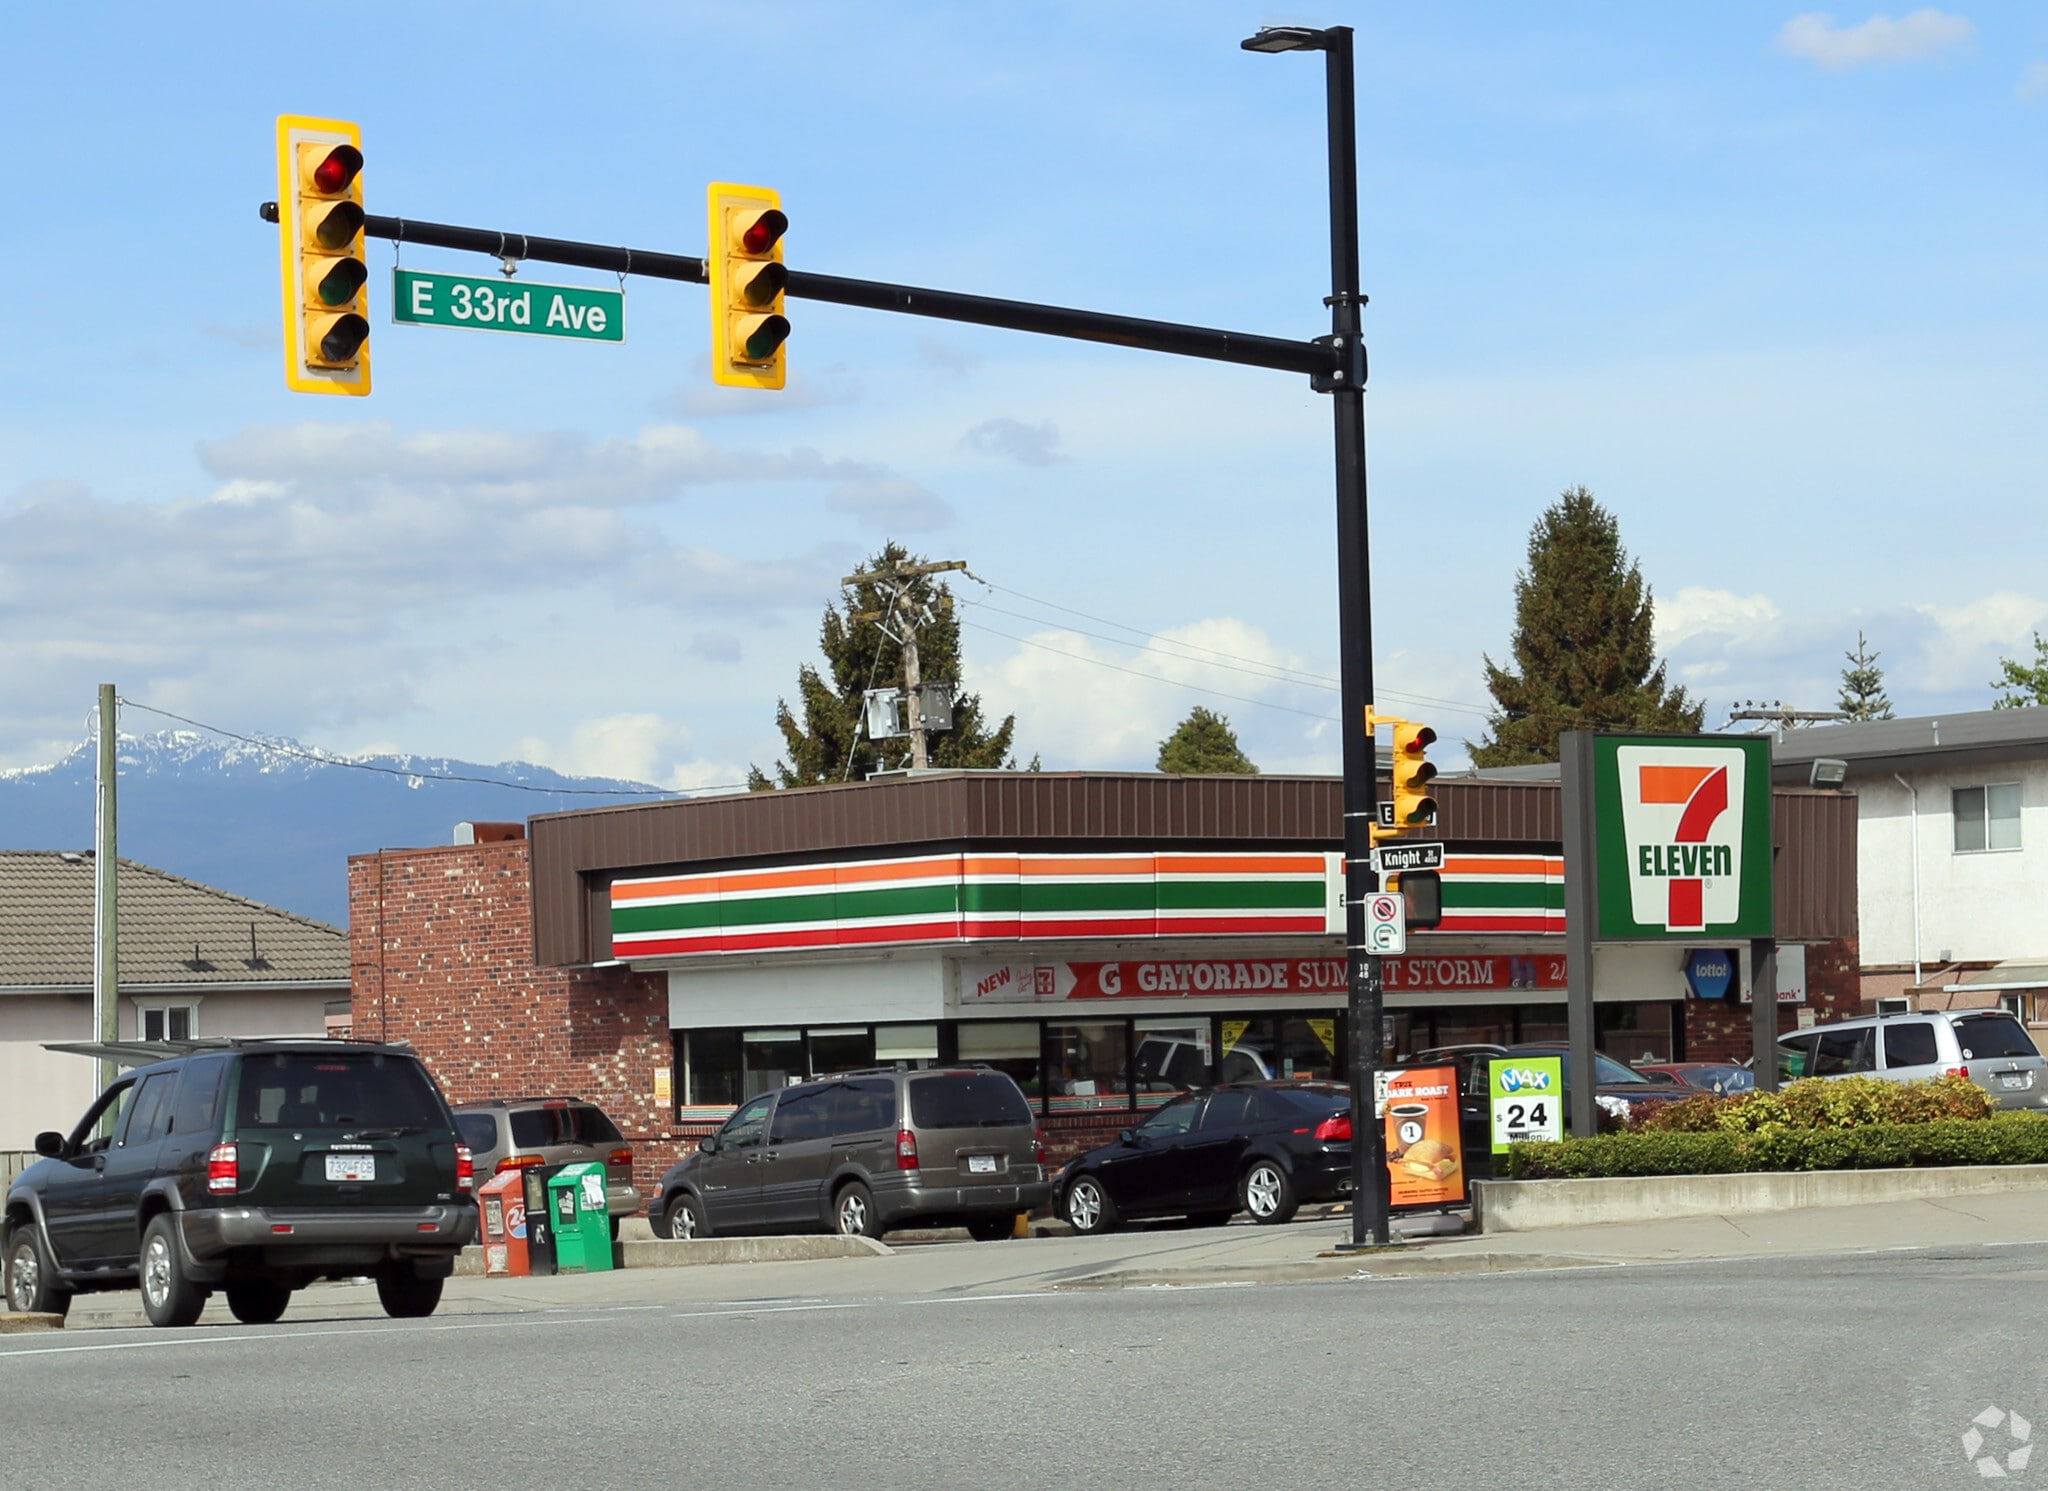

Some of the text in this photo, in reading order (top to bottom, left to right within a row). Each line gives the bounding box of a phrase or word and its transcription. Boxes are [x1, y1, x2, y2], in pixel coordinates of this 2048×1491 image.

[412, 280, 607, 332] E 33rd Ave
[1385, 807, 1392, 822] E
[1385, 851, 1421, 868] Knight
[1099, 960, 1494, 994] G GATORADE SUMIT STORM
[1696, 964, 1727, 977] lotto!
[977, 966, 1010, 997] NEW
[1500, 1068, 1547, 1092] MAX
[1414, 1085, 1449, 1097] ROAST
